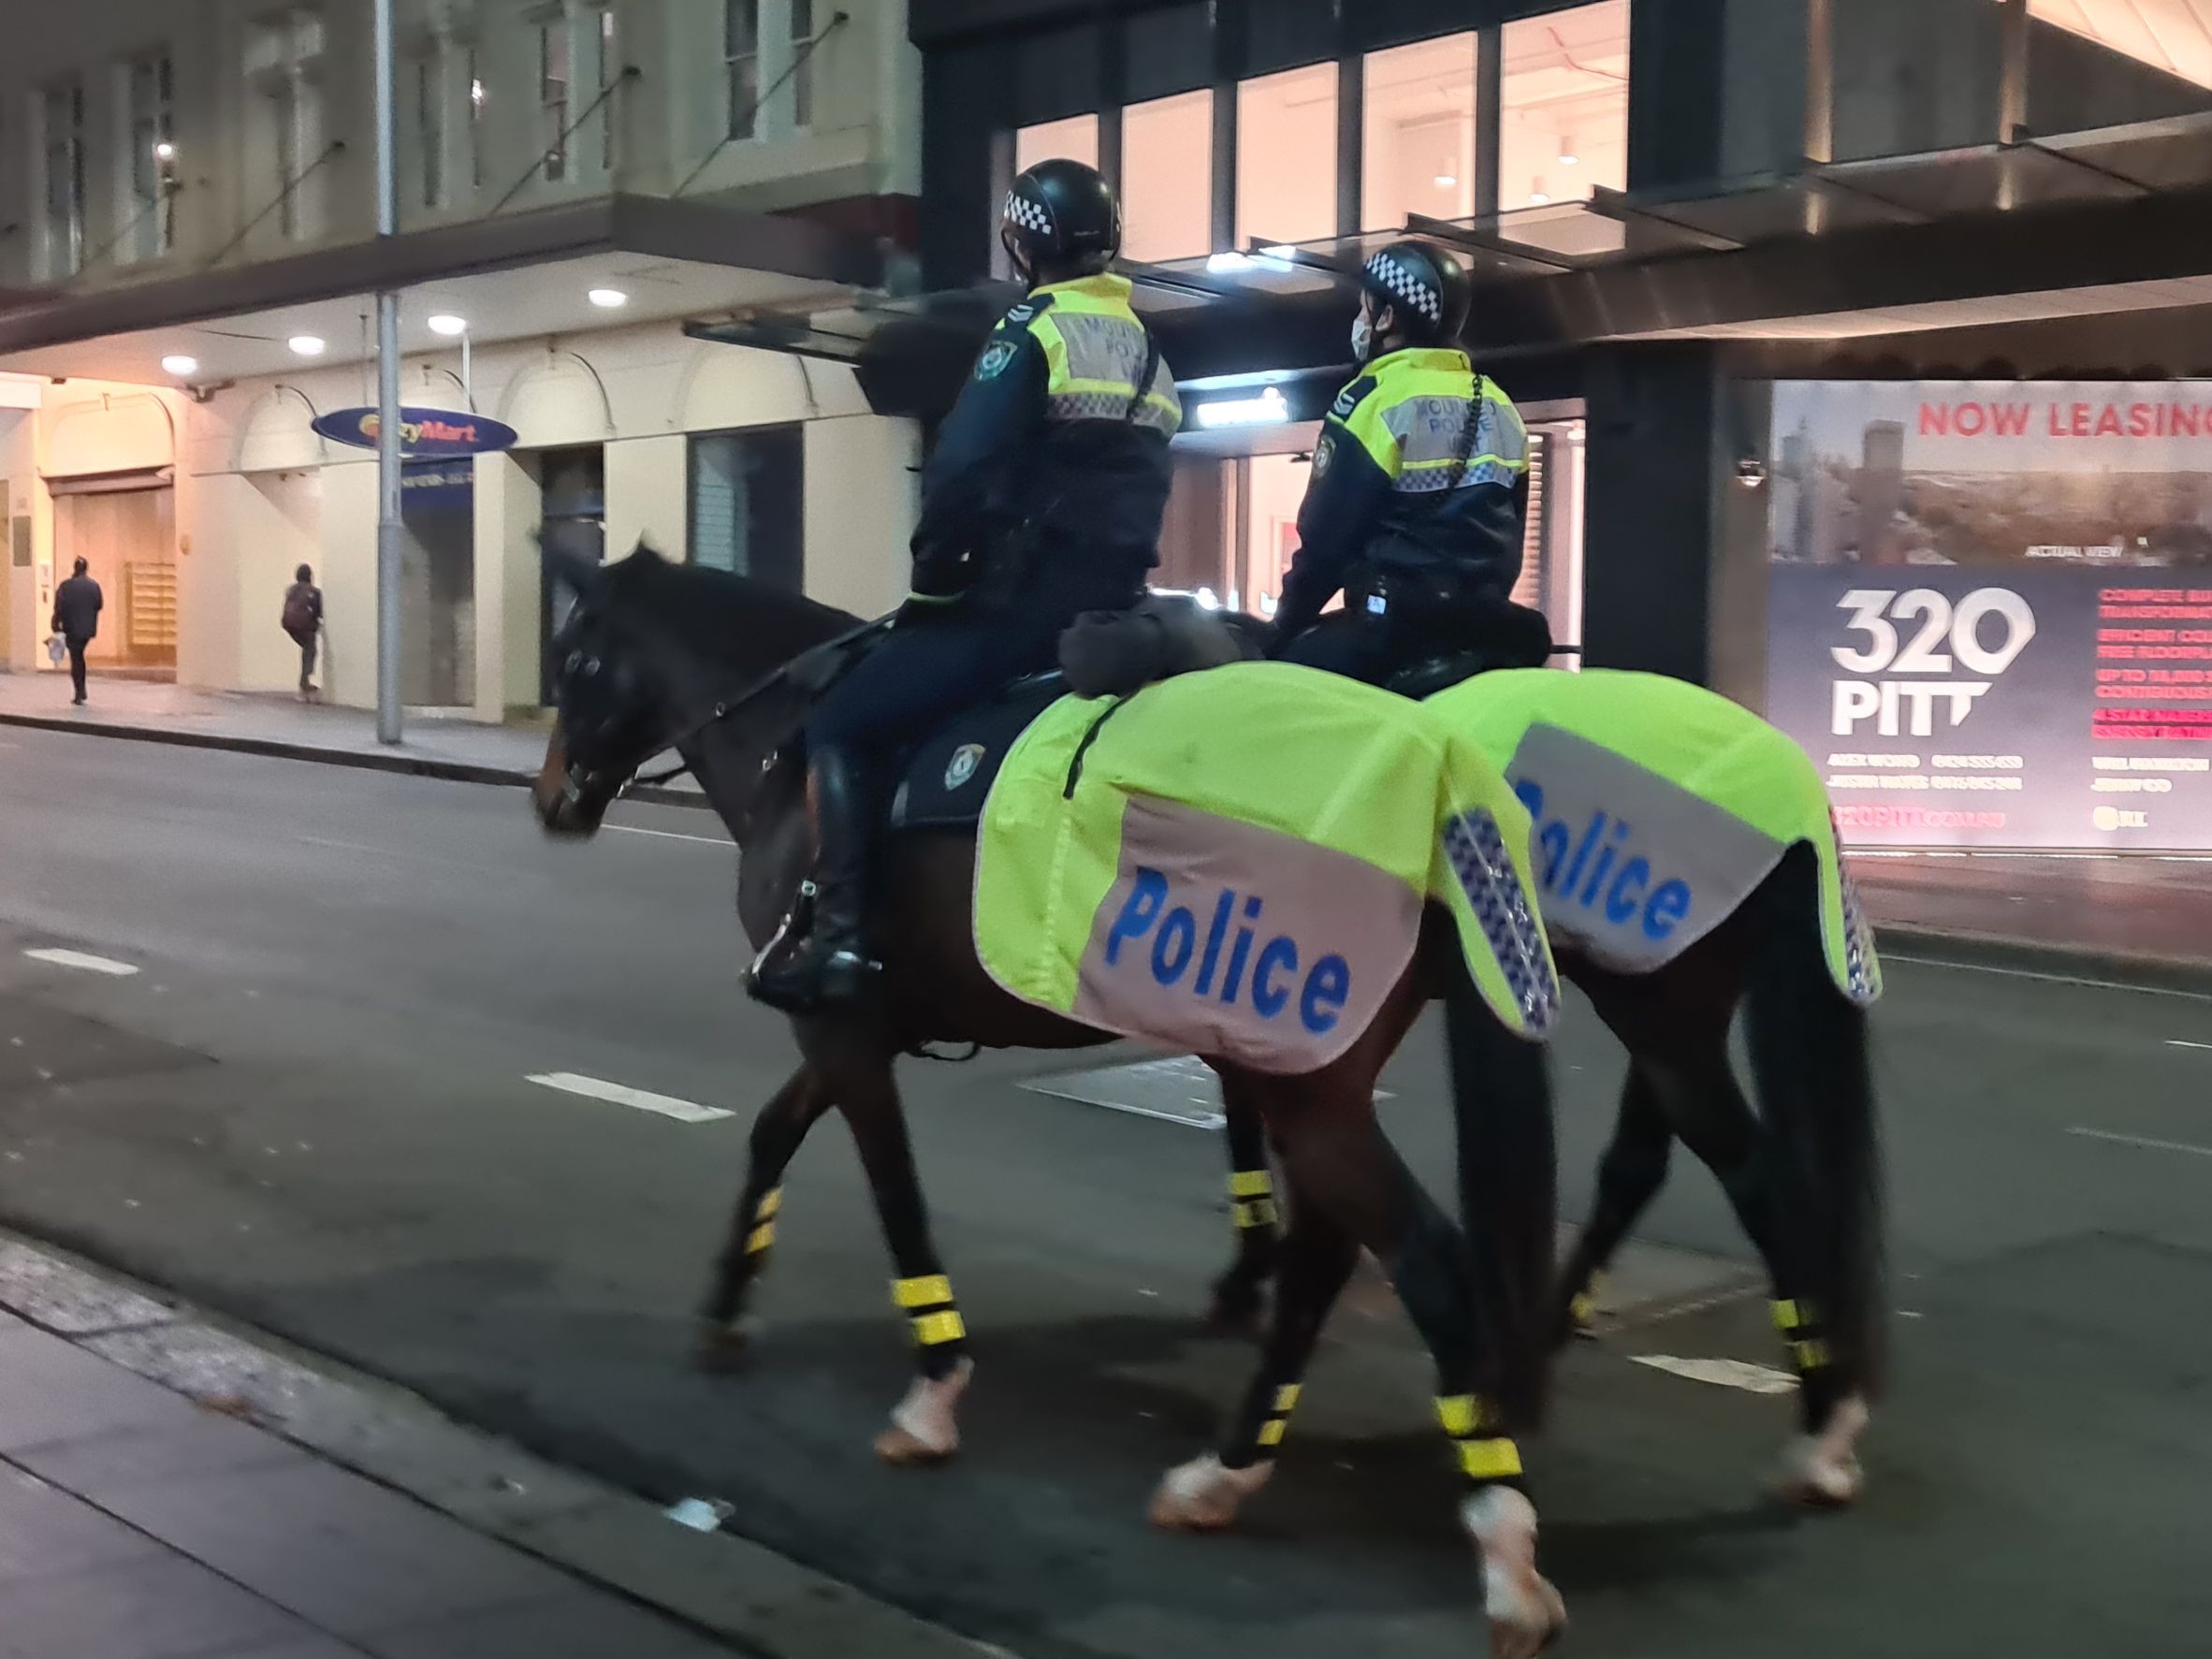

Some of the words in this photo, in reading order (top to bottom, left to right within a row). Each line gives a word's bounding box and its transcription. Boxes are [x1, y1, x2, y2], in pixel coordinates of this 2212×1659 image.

[1918, 401, 2031, 437] NOW
[2046, 402, 2212, 438] LEASIN
[1830, 587, 2037, 675] 320
[1831, 680, 1993, 736] PITT
[1105, 865, 1350, 1034] Police
